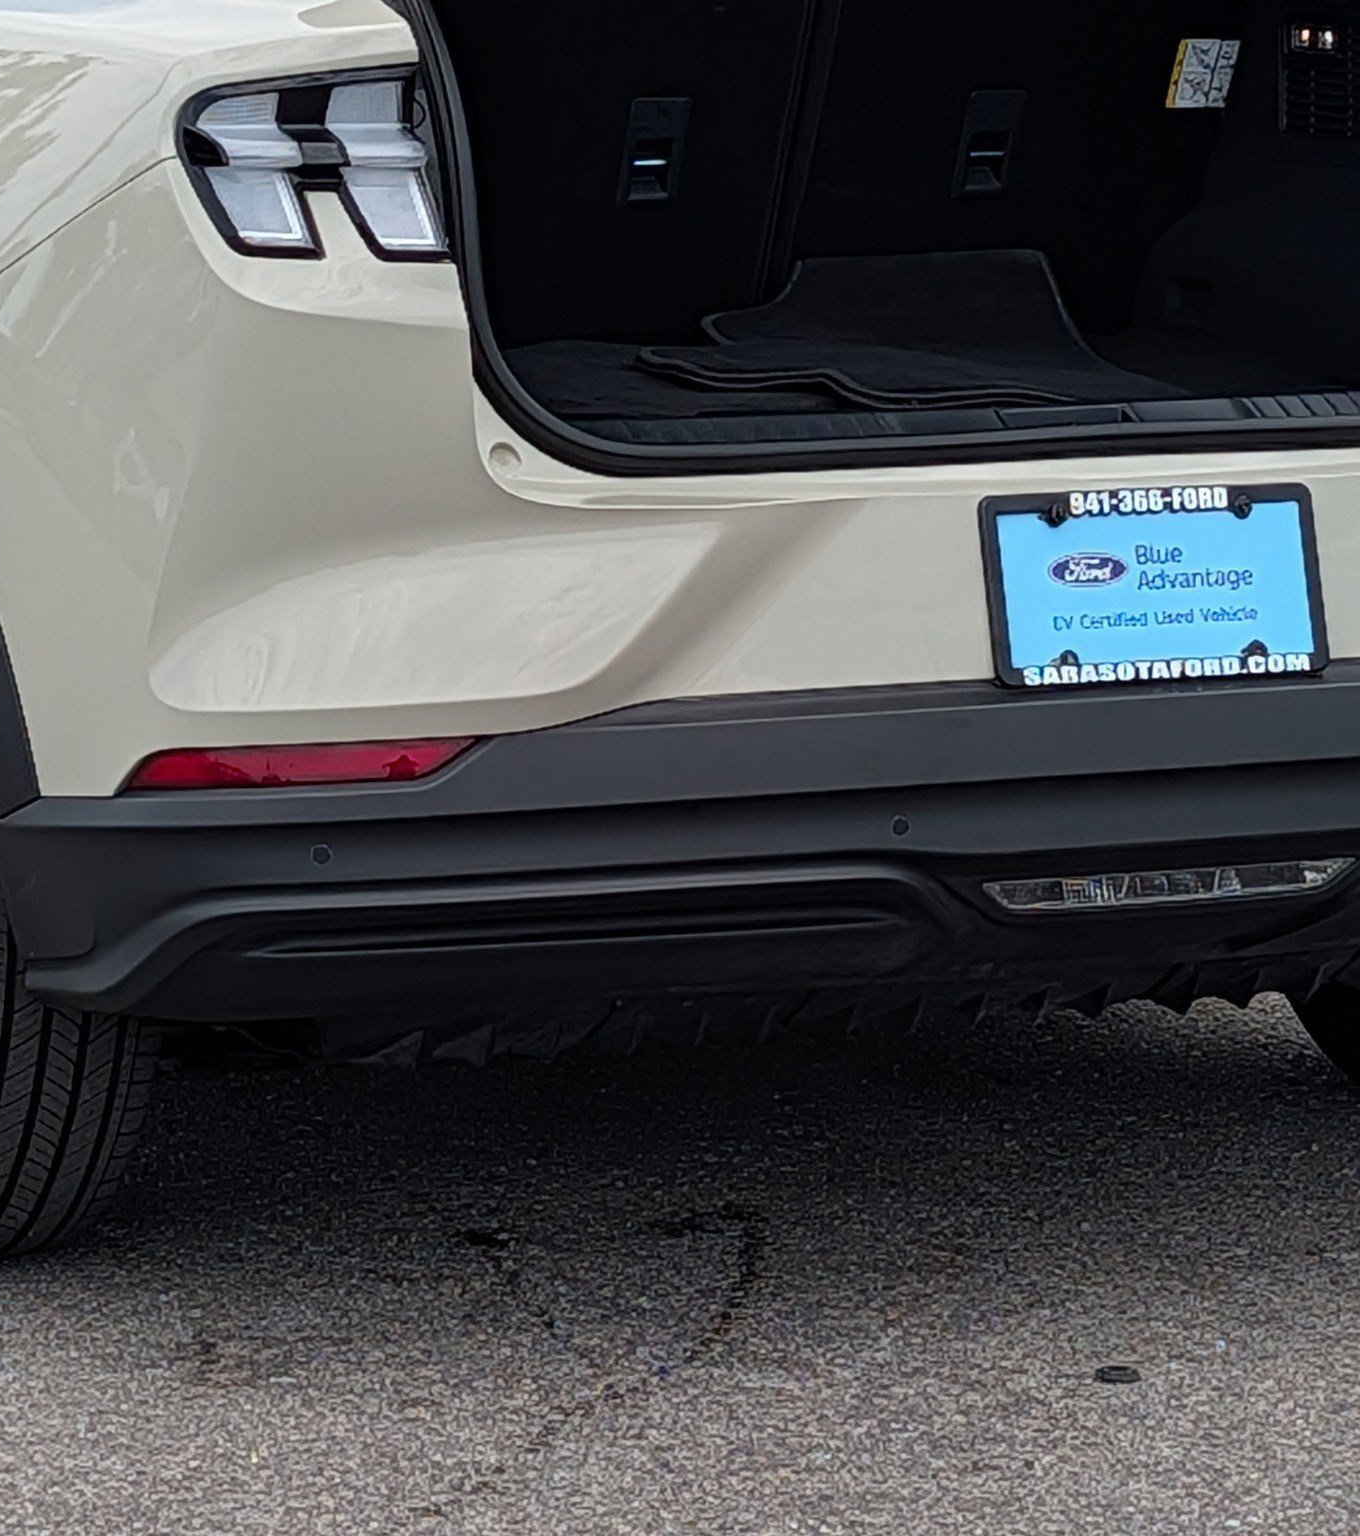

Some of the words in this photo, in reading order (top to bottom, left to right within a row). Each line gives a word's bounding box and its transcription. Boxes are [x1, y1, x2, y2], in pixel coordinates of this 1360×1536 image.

[1134, 544, 1183, 565] Blue
[1137, 568, 1253, 590] Advantage
[1053, 616, 1073, 631] EV
[1080, 611, 1148, 629] Certified
[1154, 608, 1195, 625] Used
[1200, 605, 1258, 622] Vehicle
[1023, 654, 1310, 686] SARASOTAFORD.COM
